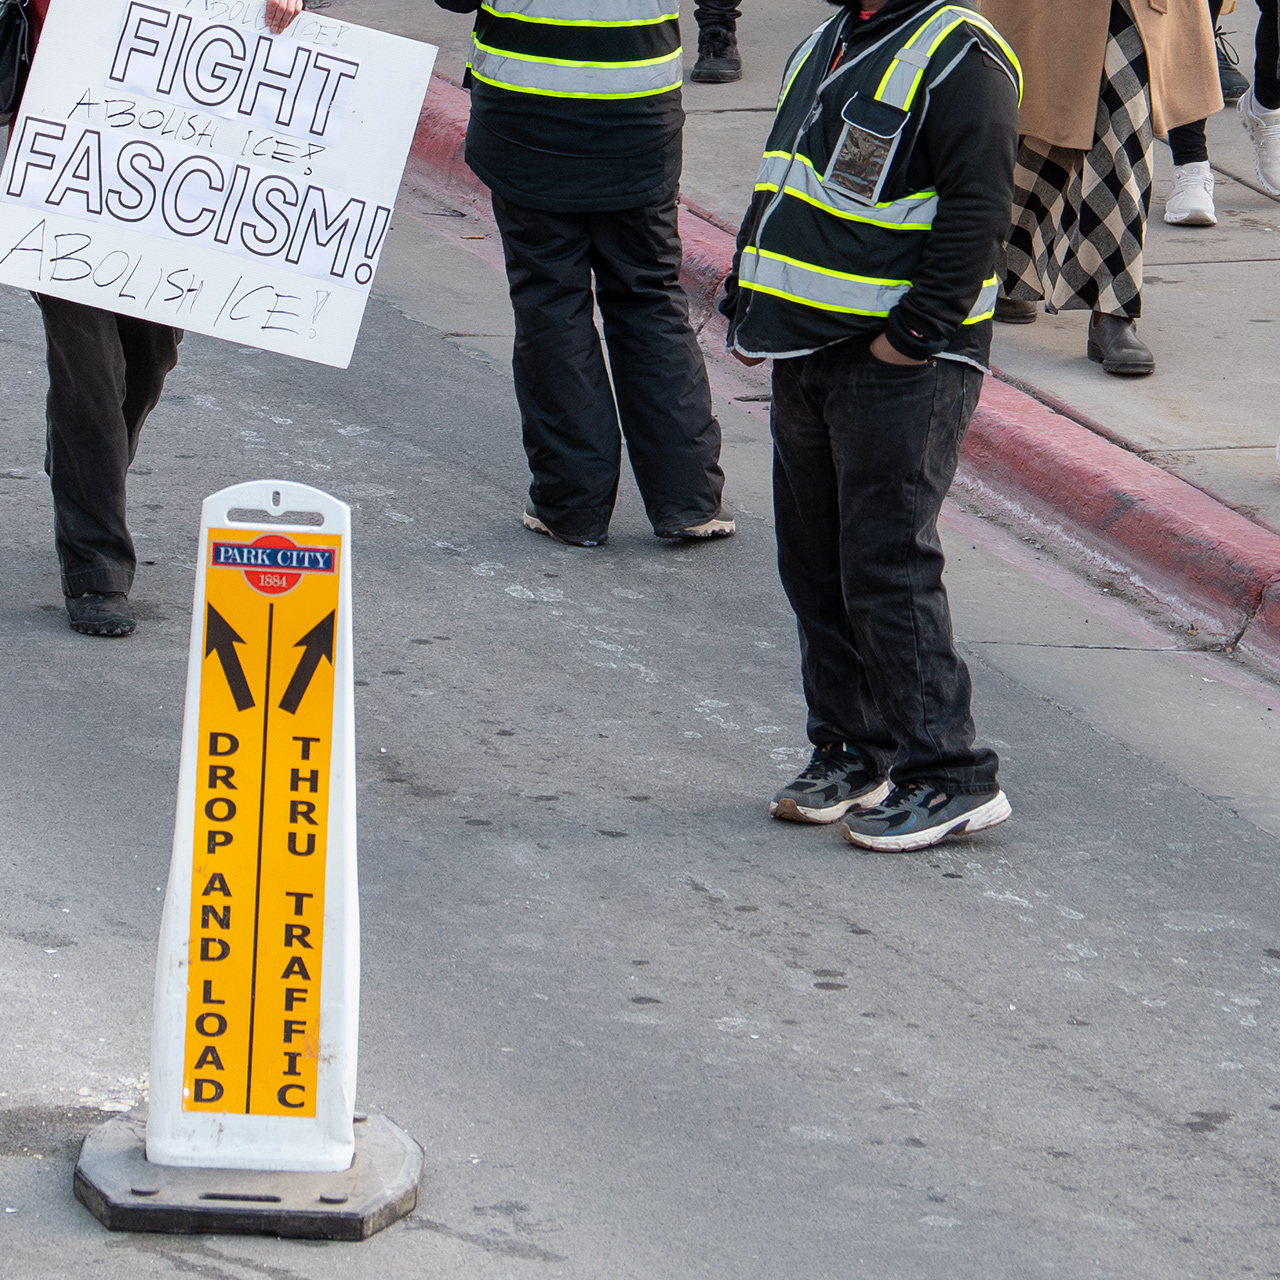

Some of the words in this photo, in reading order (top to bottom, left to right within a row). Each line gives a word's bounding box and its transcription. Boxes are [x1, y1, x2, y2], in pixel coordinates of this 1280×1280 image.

[109, 0, 359, 136] FIGHT
[67, 87, 218, 148] ABOLISH
[242, 129, 325, 175] ICE!
[6, 116, 391, 285] FASCISM!
[213, 275, 331, 339] ICE!
[218, 546, 273, 565] PARK
[277, 549, 329, 568] CITY
[259, 574, 288, 587] 1884
[204, 732, 240, 854] DROP
[287, 736, 320, 857] THRU
[200, 872, 232, 962] AND
[193, 979, 228, 1103] LOAD
[277, 891, 314, 1108] TRAFFIC
